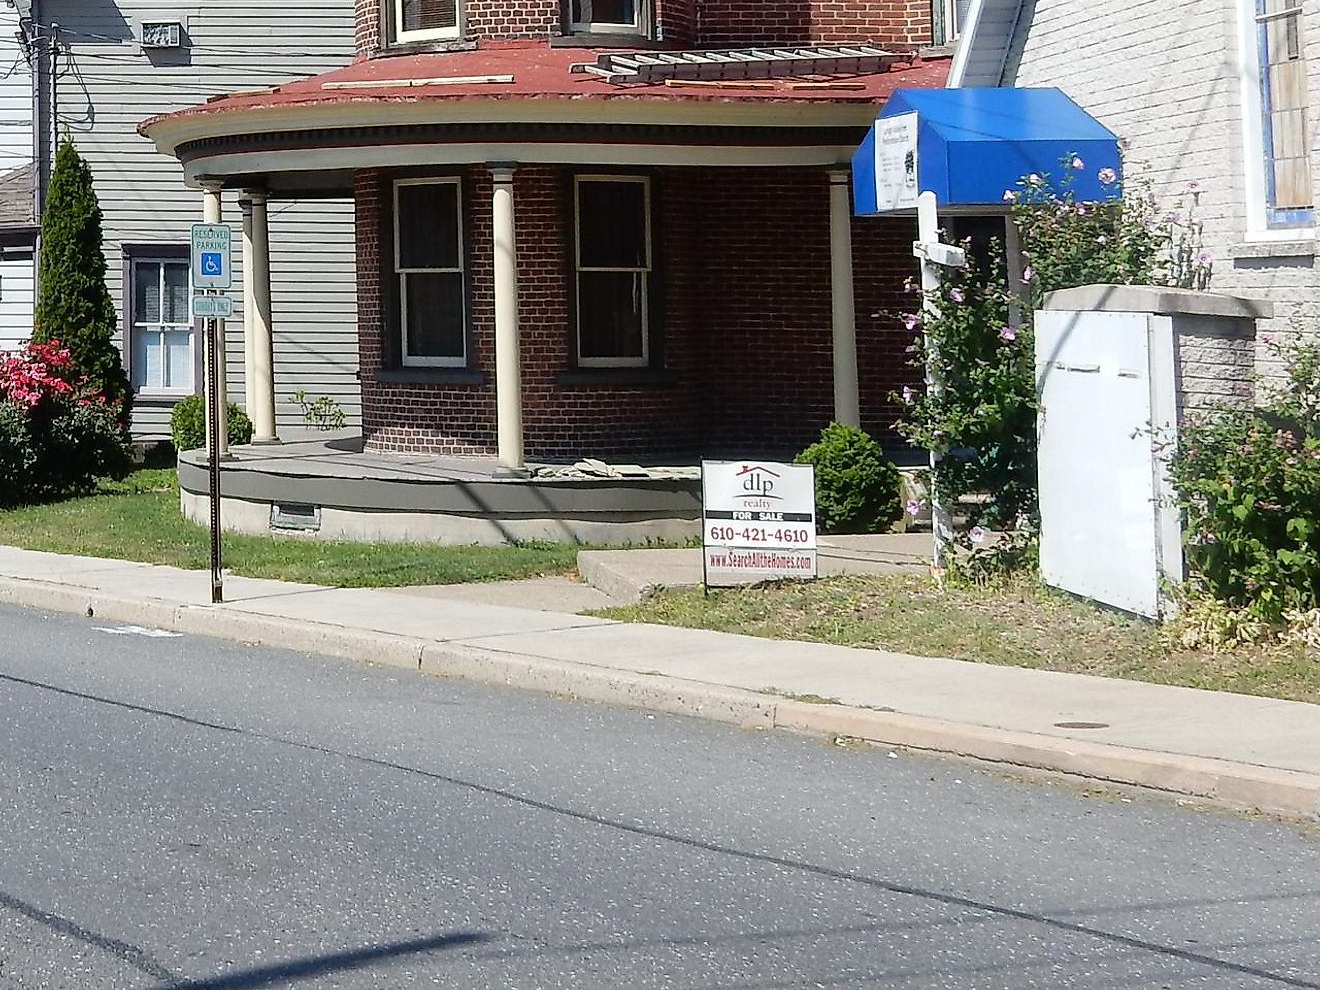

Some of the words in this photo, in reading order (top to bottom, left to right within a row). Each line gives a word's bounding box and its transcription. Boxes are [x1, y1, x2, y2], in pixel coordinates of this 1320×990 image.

[194, 229, 228, 239] RESERVED
[196, 241, 227, 250] PARKING
[742, 473, 774, 496] dlp
[743, 498, 772, 510] realty
[732, 512, 752, 521] FOR
[758, 512, 785, 521] SALE
[710, 526, 809, 543] 610-421-4610
[709, 552, 812, 570] www.SearchAlltheHomes.com
